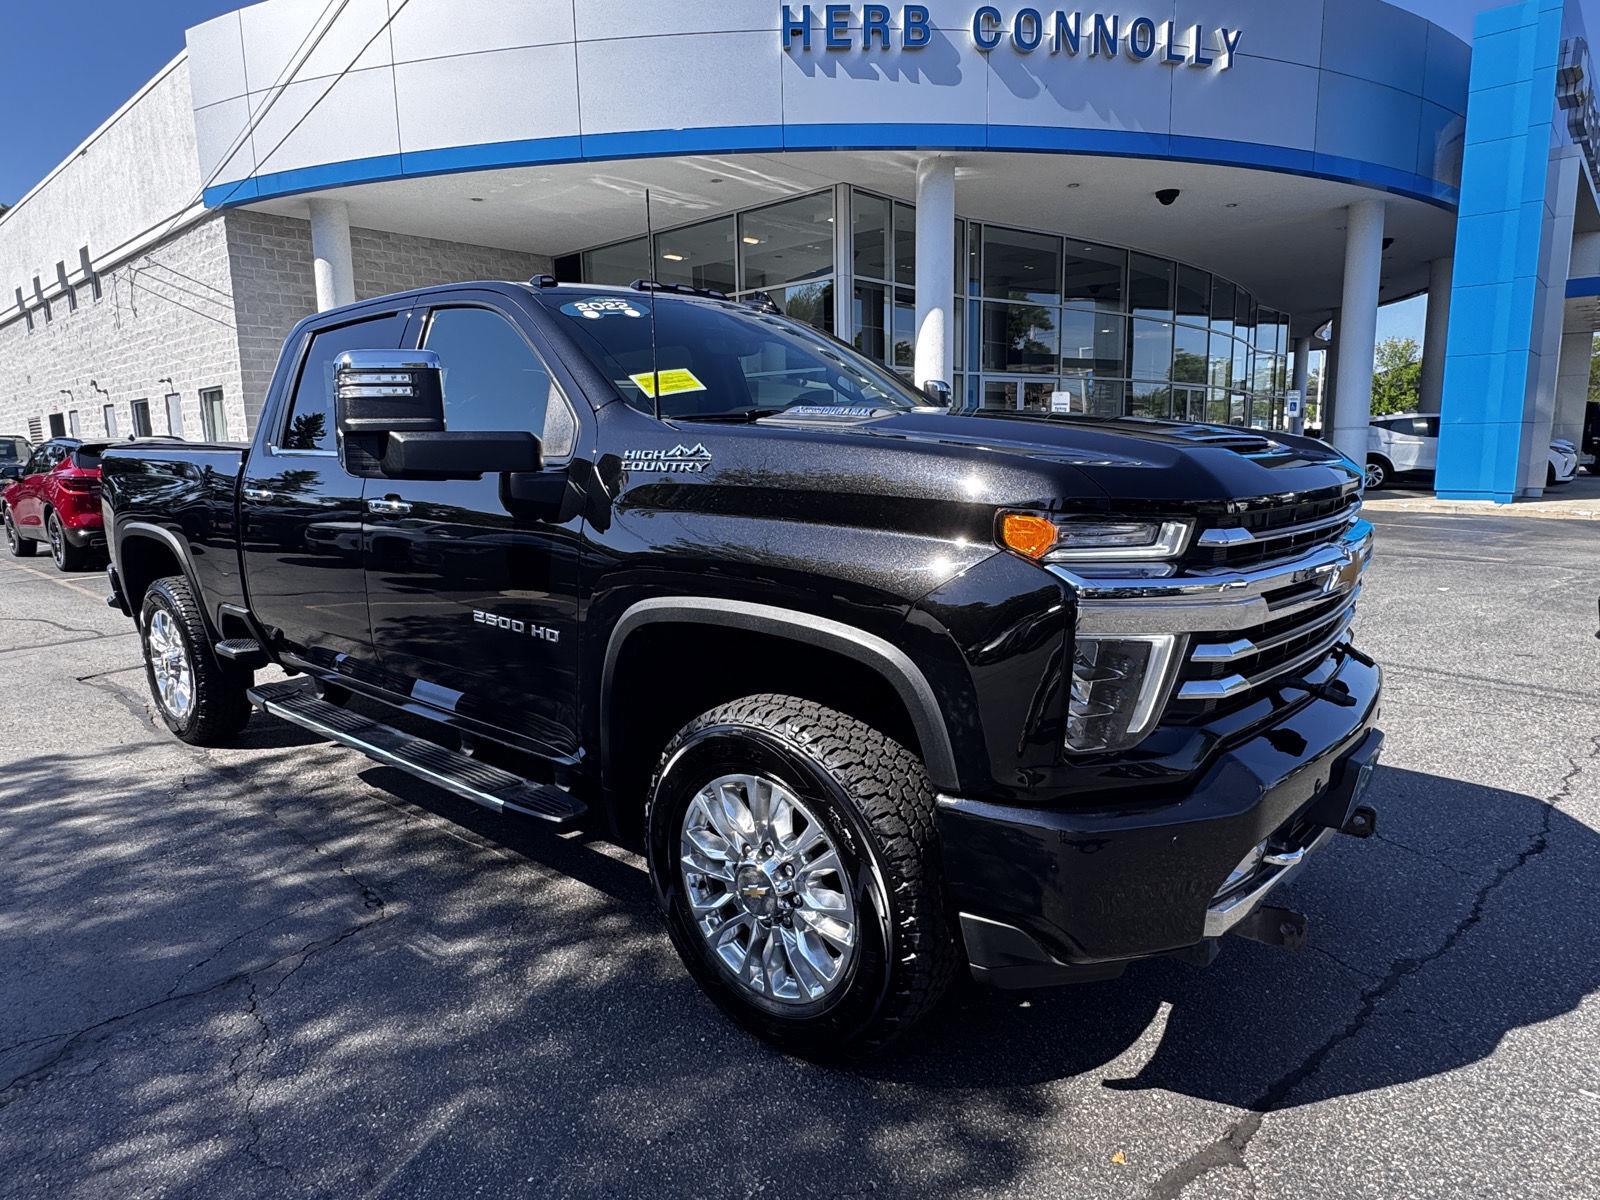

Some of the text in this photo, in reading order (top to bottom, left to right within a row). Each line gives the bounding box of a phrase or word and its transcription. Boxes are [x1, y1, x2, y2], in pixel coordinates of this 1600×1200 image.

[781, 4, 1243, 72] HERB CONNOLLY
[574, 302, 633, 312] 2022
[623, 449, 667, 460] HIGH
[621, 461, 712, 473] COUNTRY
[472, 609, 561, 643] 2500 HD
